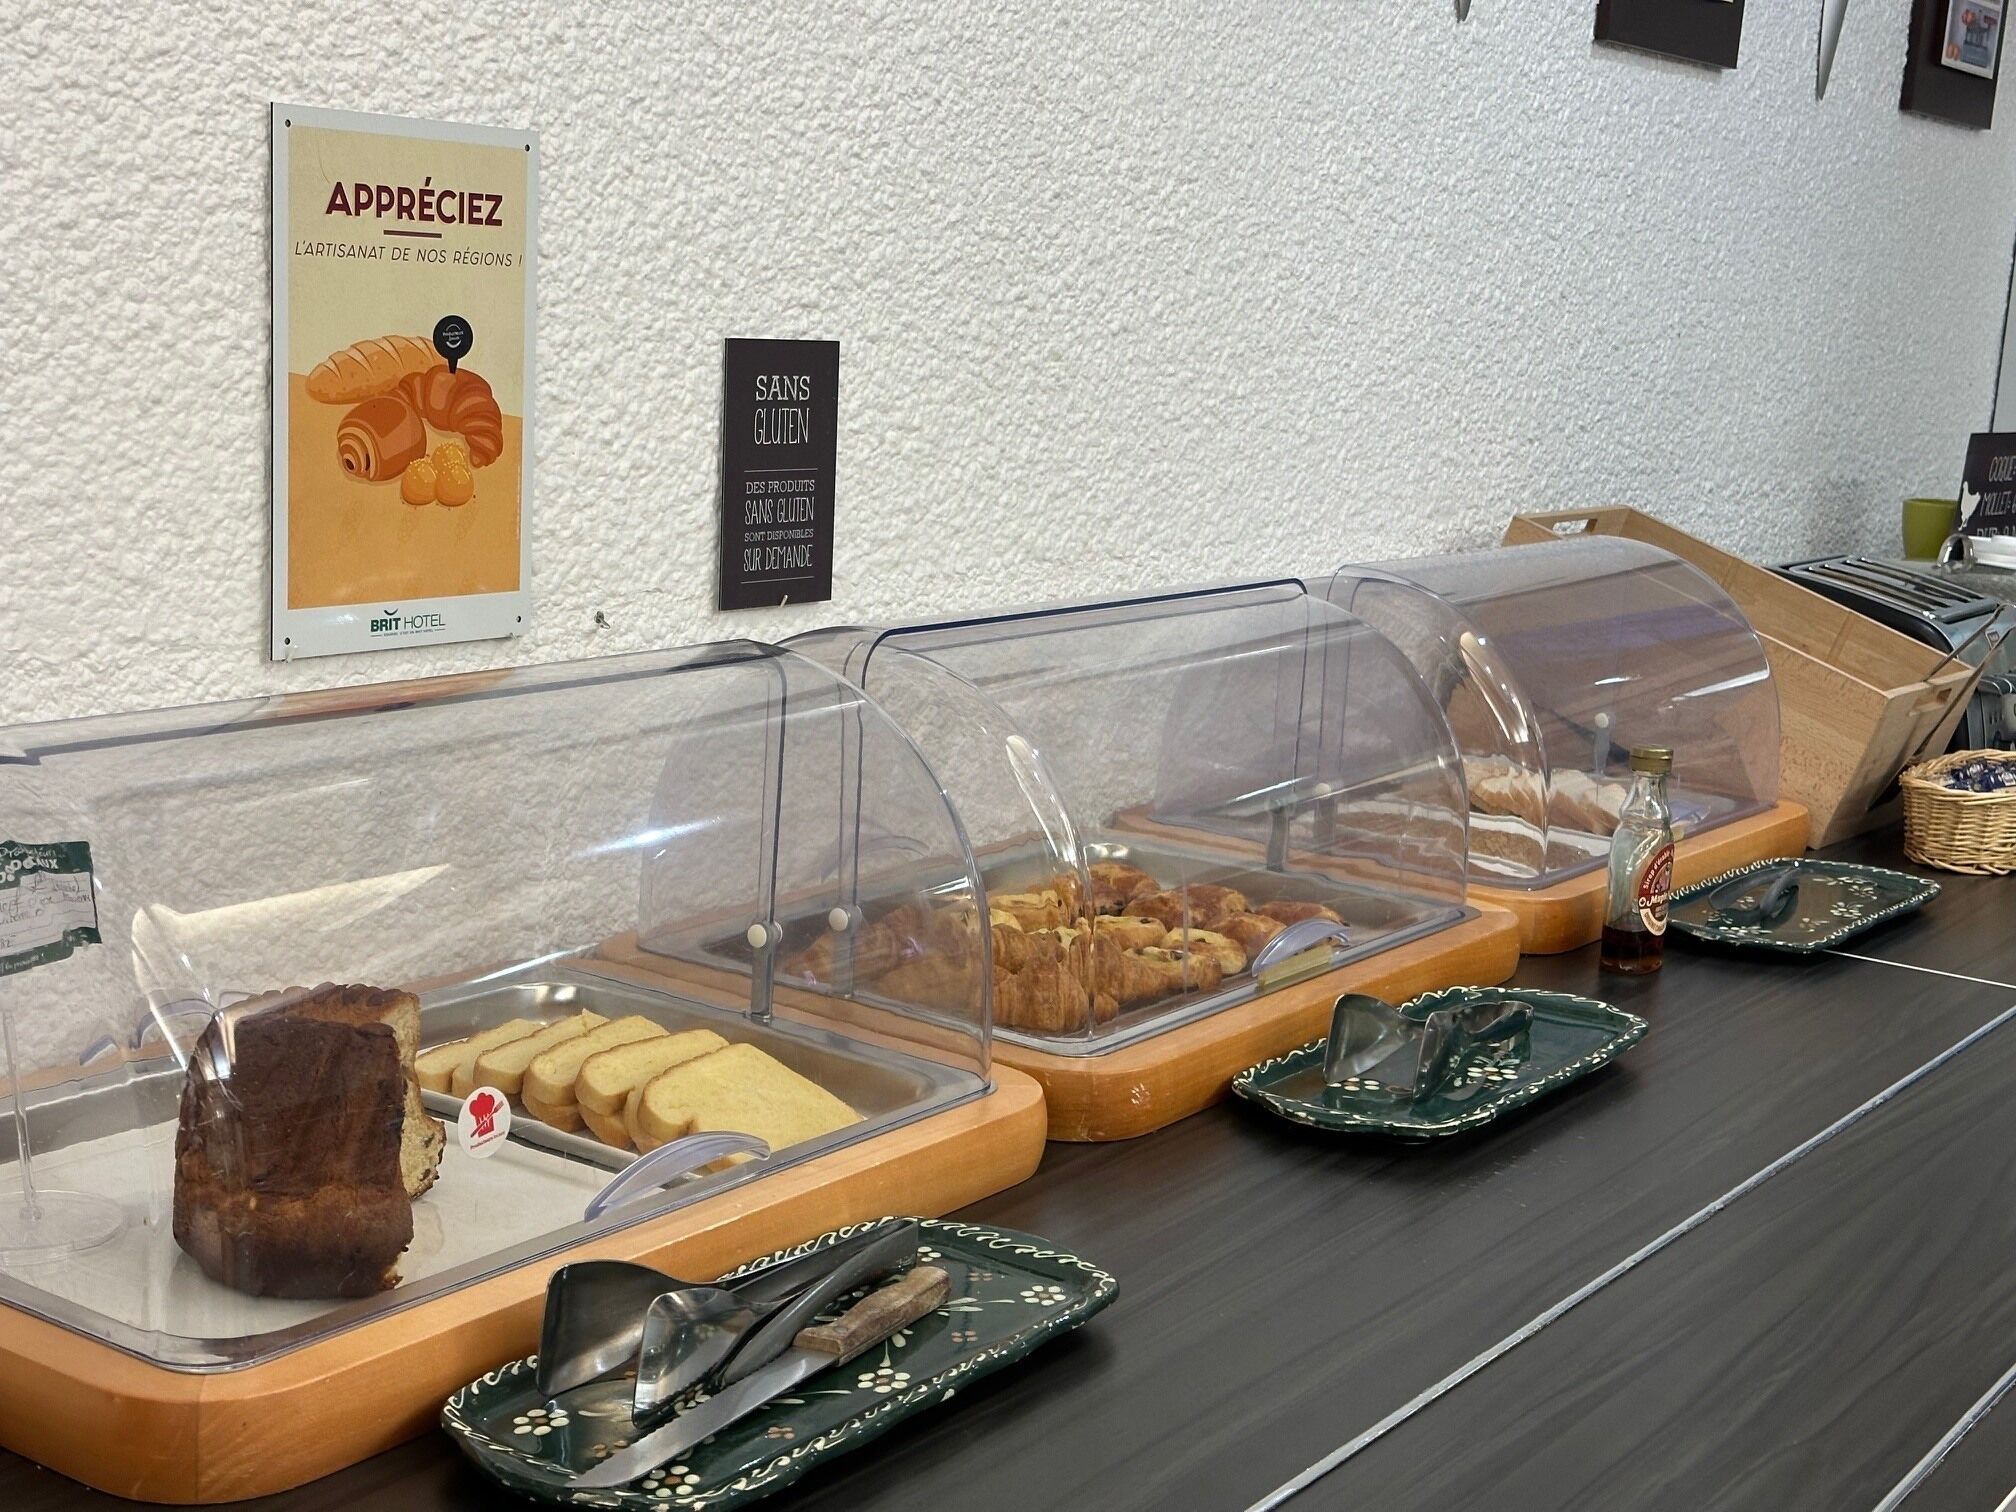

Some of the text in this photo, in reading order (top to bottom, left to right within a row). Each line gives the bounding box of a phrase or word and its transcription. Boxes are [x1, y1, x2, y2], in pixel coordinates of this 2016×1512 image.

[325, 176, 503, 227] APPRÉCIEZ
[294, 240, 523, 268] L'ARTISANAT DE NOS RÉGIONS !
[755, 374, 811, 401] SANS
[753, 407, 810, 445] GLUTEN
[745, 479, 815, 494] DES PRODUITS
[744, 497, 815, 525] SANS GLUTEN
[744, 528, 814, 542] SONT DISPONIBLES
[743, 544, 813, 572] SUR DEMANDE
[370, 618, 401, 633] BRIT
[403, 614, 446, 630] HOTEL
